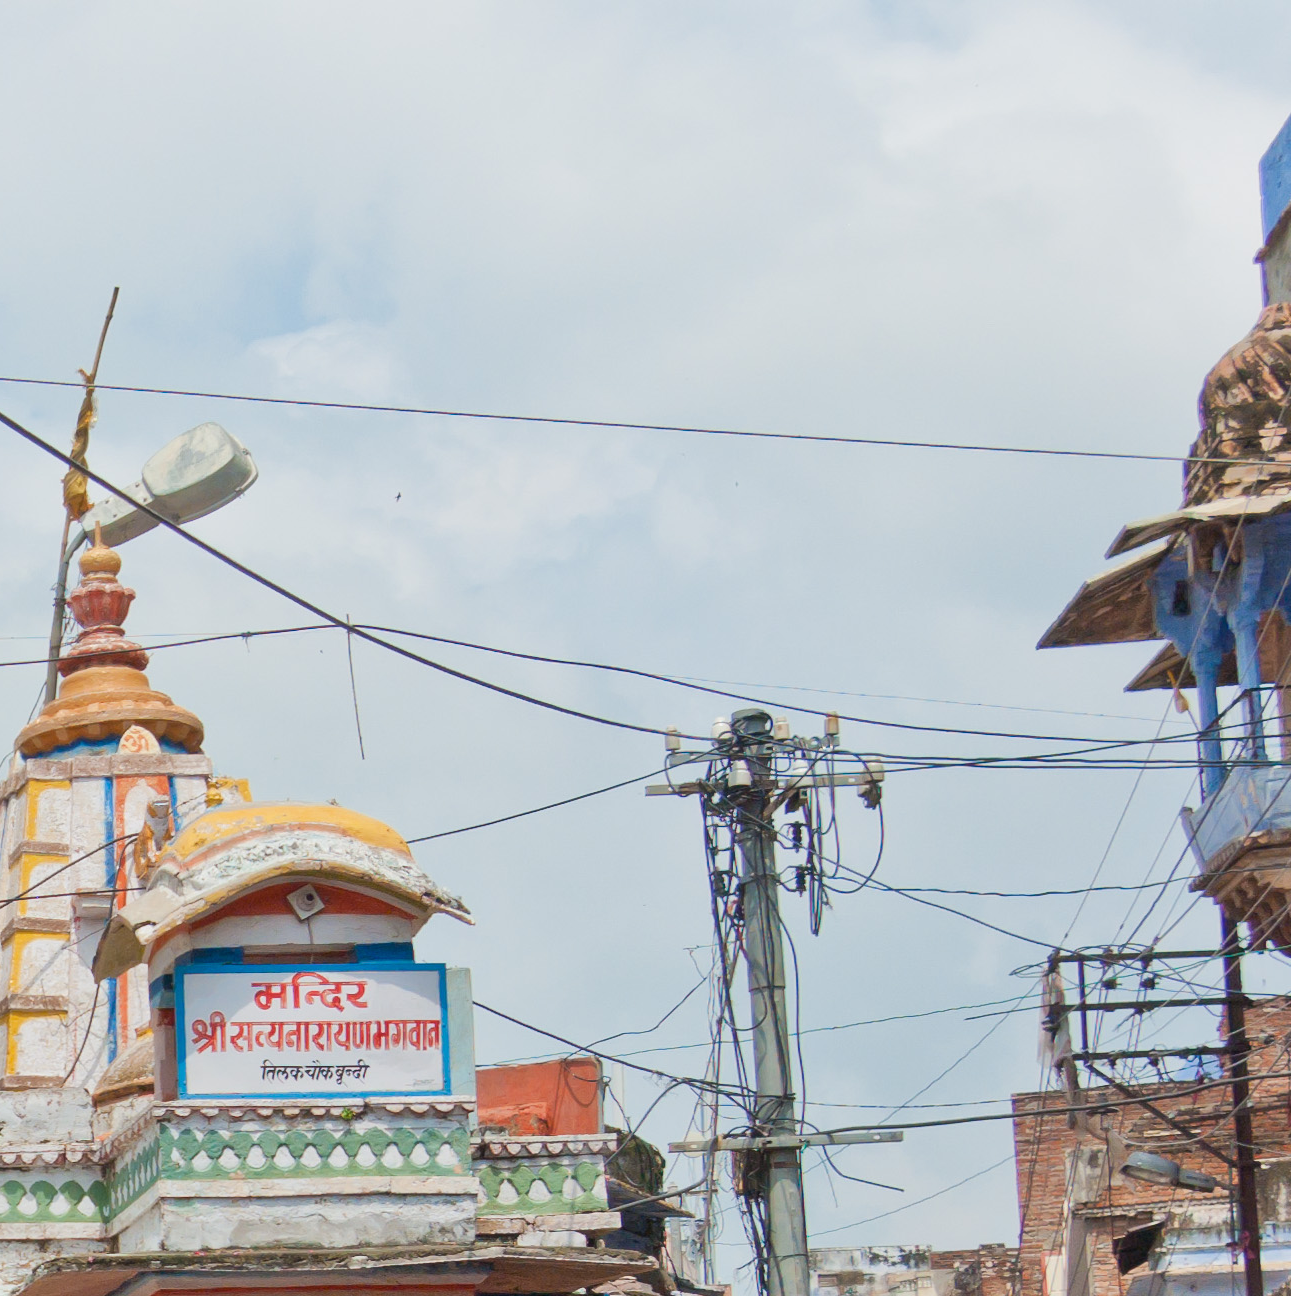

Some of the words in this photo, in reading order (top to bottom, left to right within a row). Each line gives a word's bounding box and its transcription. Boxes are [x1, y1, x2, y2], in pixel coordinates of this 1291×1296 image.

[251, 972, 368, 1012] मन्दिर
[191, 1011, 227, 1053] श्री
[260, 1059, 304, 1083] तिलक
[304, 1060, 335, 1082] चौक
